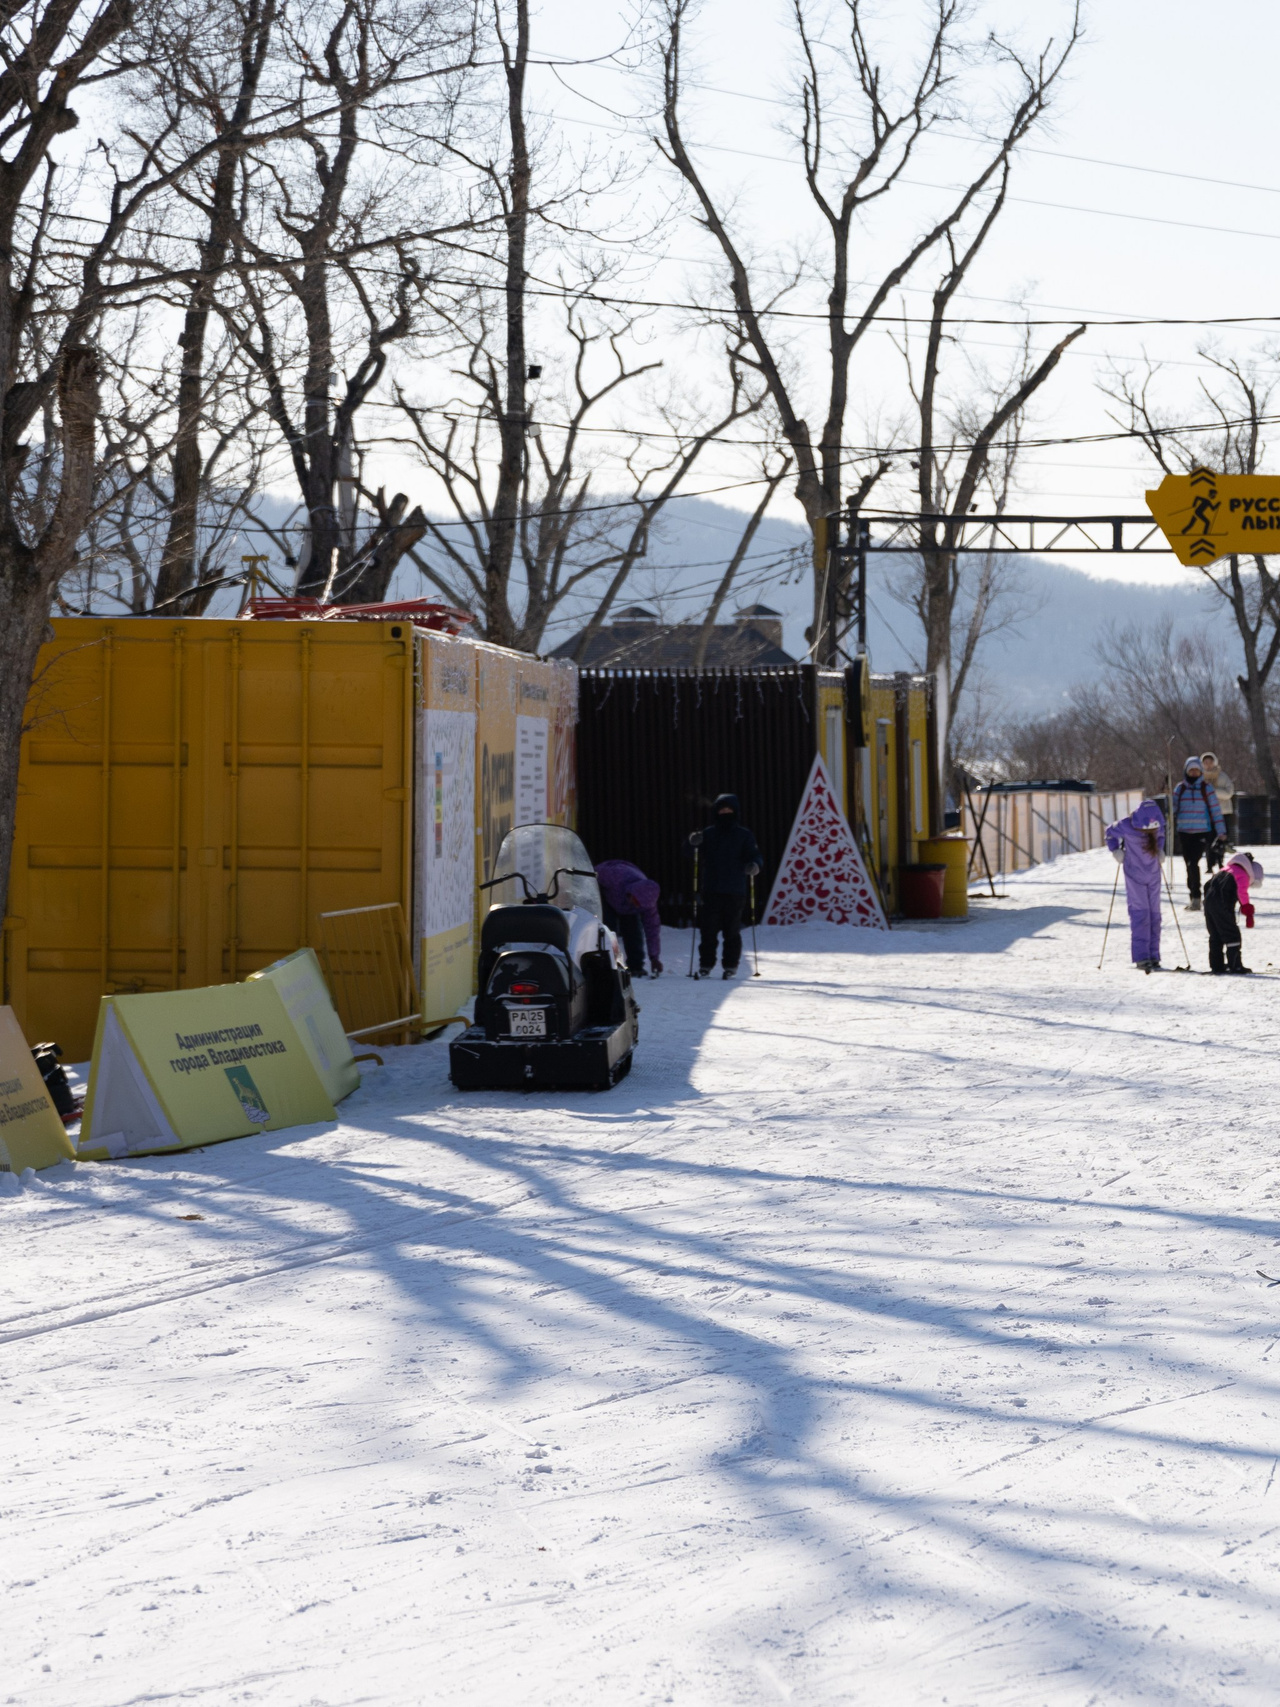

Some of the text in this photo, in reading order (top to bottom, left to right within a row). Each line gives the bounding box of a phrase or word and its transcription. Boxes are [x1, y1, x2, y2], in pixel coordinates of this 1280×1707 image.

[530, 1011, 543, 1021] 25
[175, 1023, 263, 1051] Администрация
[169, 1040, 287, 1075] города Владивостока
